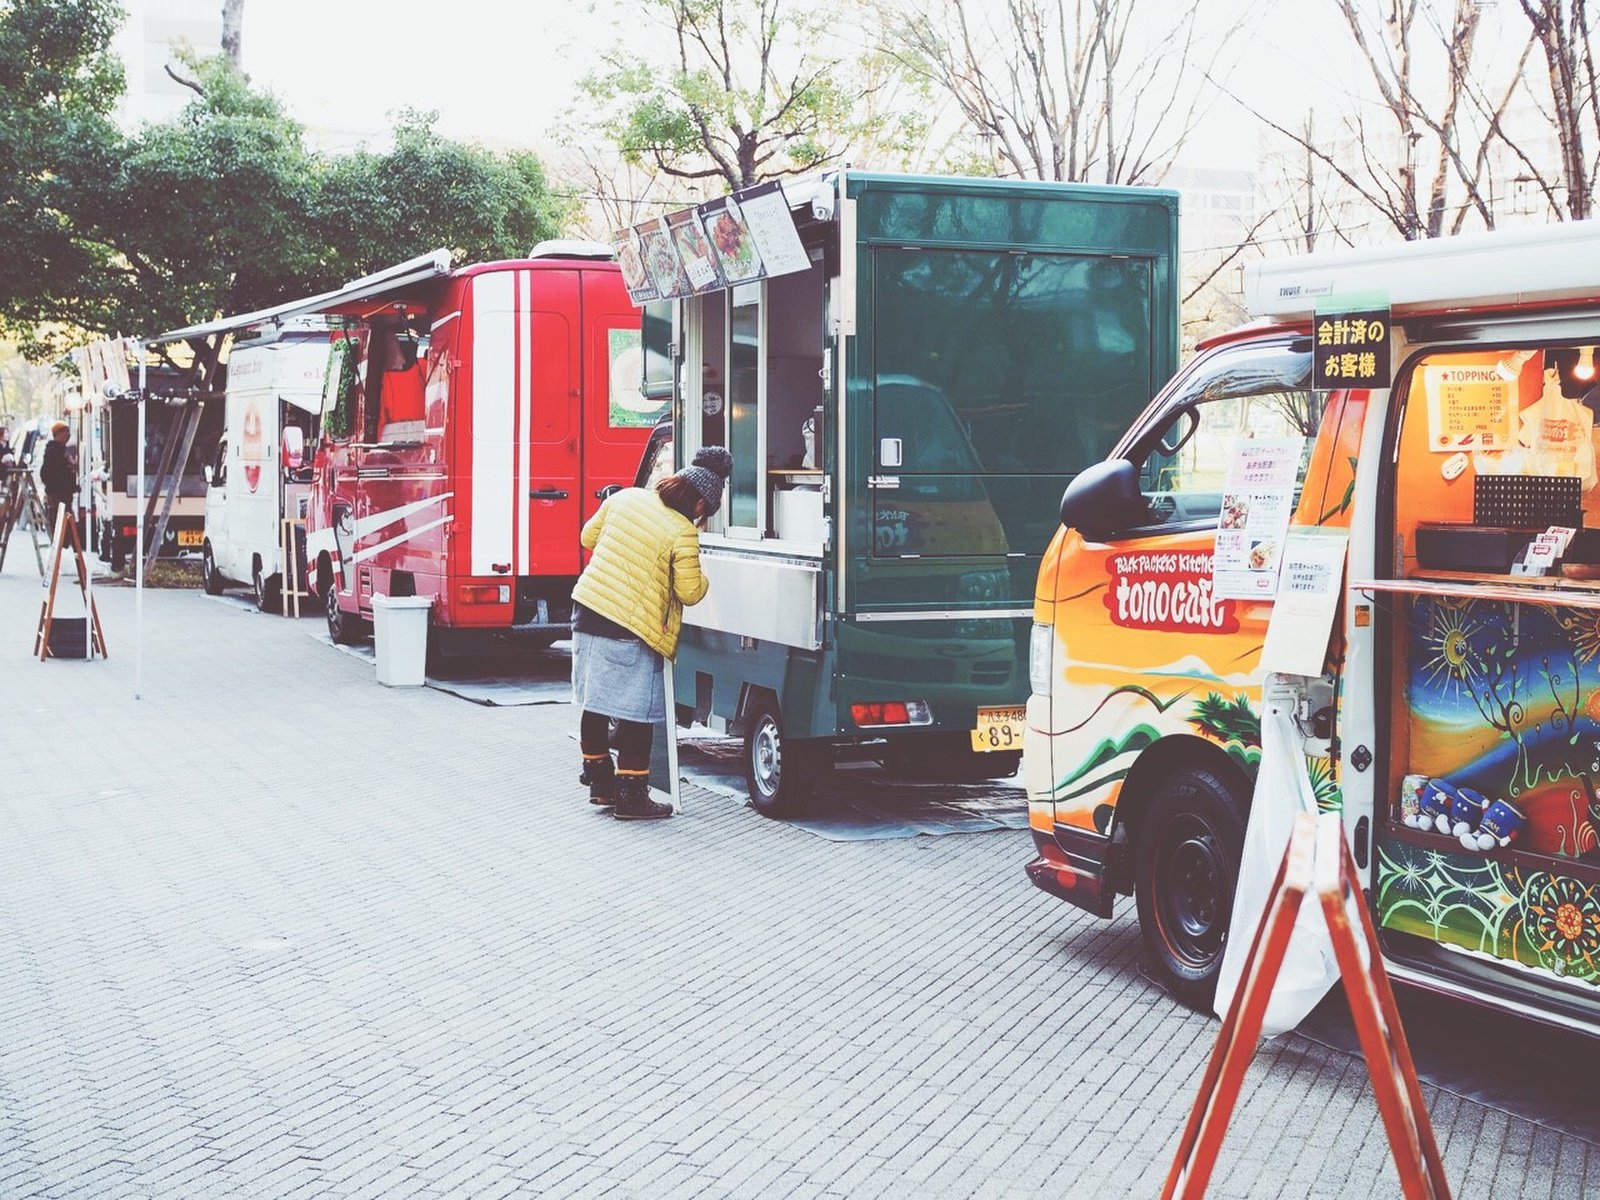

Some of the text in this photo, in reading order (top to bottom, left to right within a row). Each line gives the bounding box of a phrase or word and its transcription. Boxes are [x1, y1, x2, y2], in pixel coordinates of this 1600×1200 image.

[1318, 319, 1385, 345] 会計済の
[1325, 352, 1376, 378] お客様
[1450, 370, 1496, 382] TOPPING
